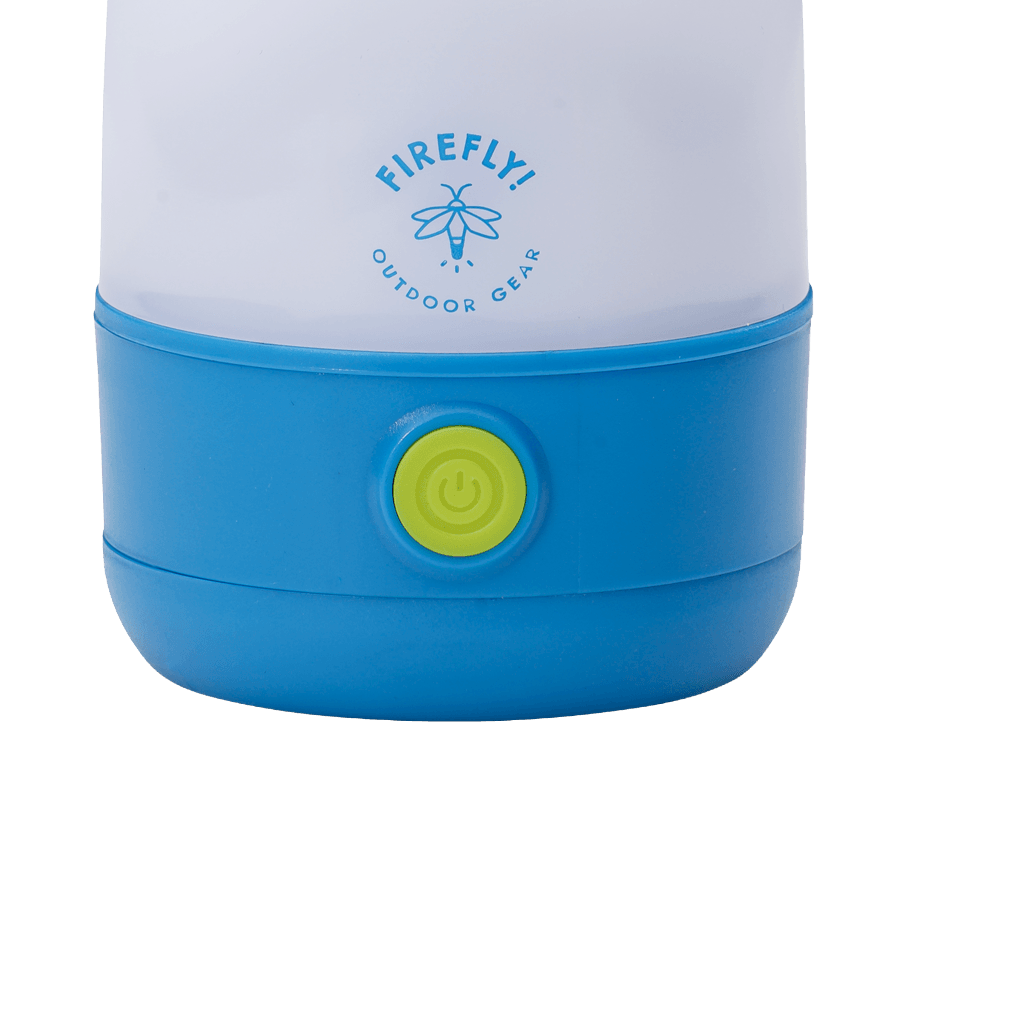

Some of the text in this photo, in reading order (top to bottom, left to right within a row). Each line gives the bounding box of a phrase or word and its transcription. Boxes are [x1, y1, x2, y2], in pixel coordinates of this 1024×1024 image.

[375, 132, 536, 193] FIREFLY!
[372, 248, 540, 313] OUTDOOR GEAR
